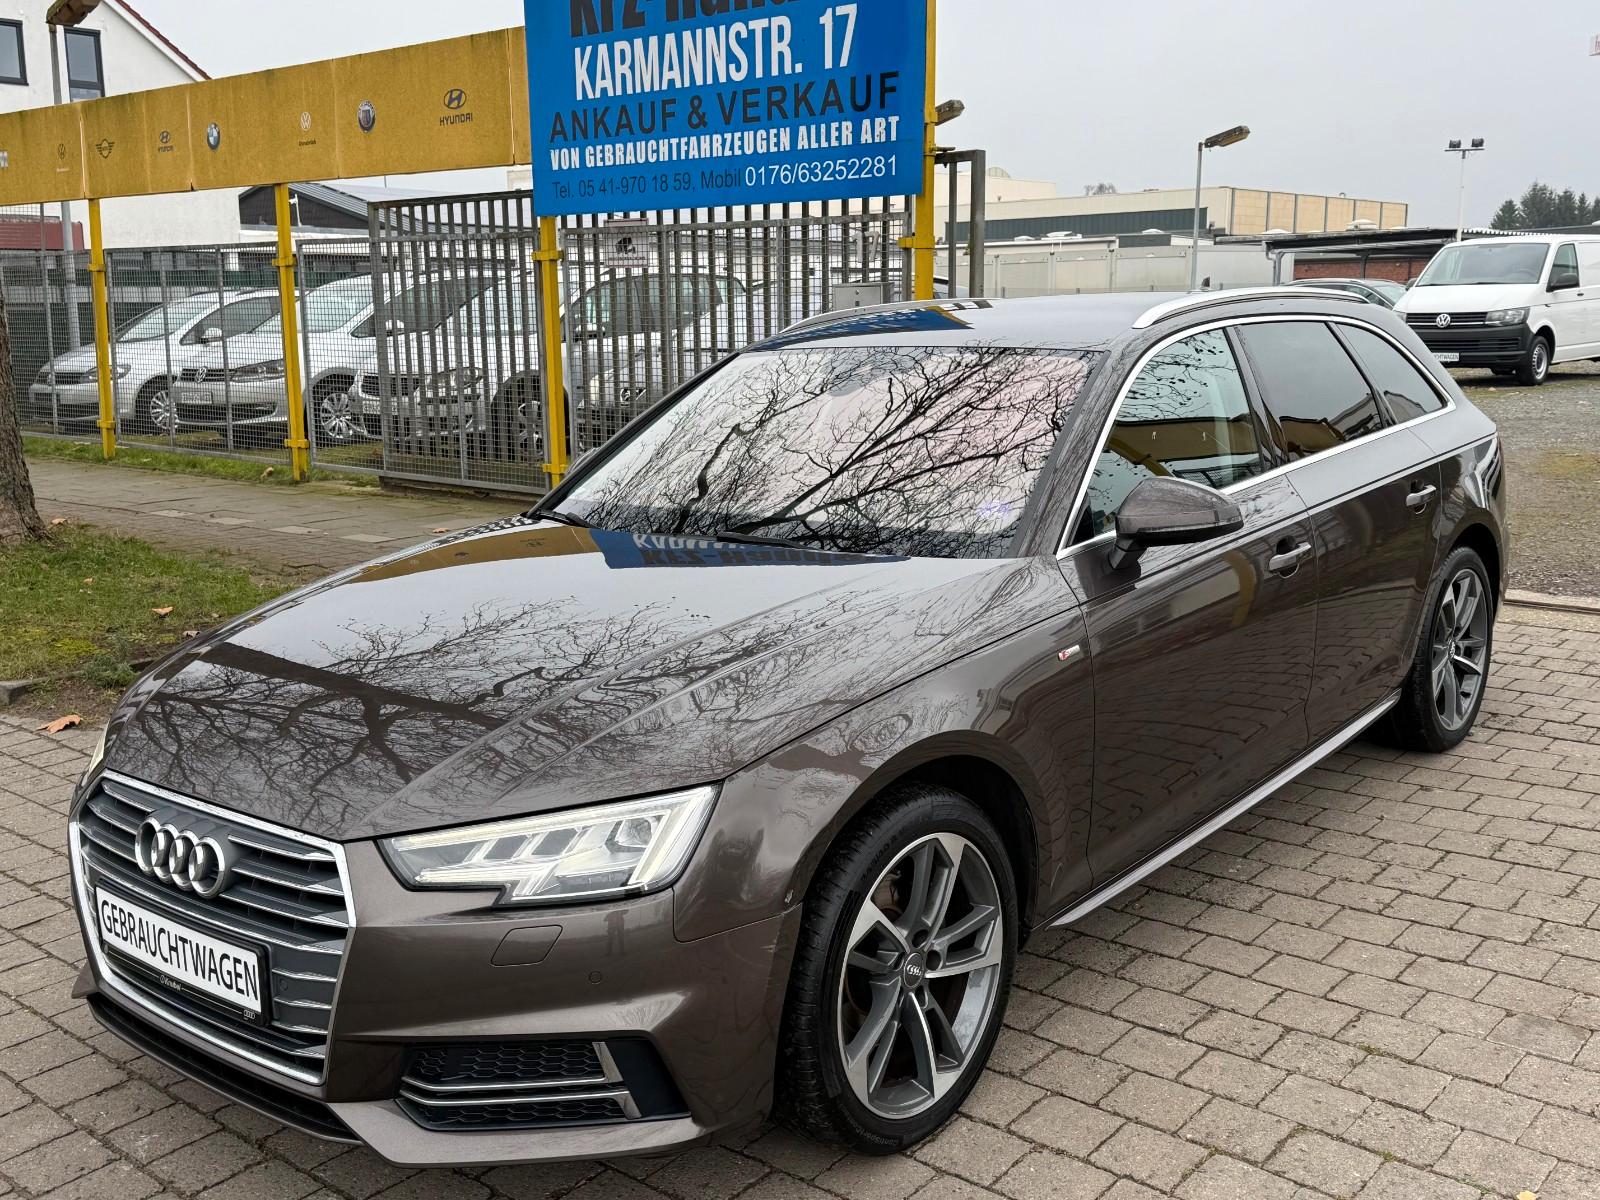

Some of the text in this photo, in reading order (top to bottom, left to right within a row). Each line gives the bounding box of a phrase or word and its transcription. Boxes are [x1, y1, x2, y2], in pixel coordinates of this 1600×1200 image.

[575, 15, 803, 101] KARMANNSTR.
[819, 3, 858, 69] 17
[439, 112, 473, 126] HYUNDAI
[550, 71, 899, 143] ANKAUF & VERKAUF
[550, 115, 899, 171] VON GEBRAUCHTFAHRZEUGEN ALLER ART
[552, 154, 897, 199] Tel. 05 41-970 18 59, Mobil 0176/63252281
[101, 900, 260, 1001] GEBRAUCHTWAGEN
